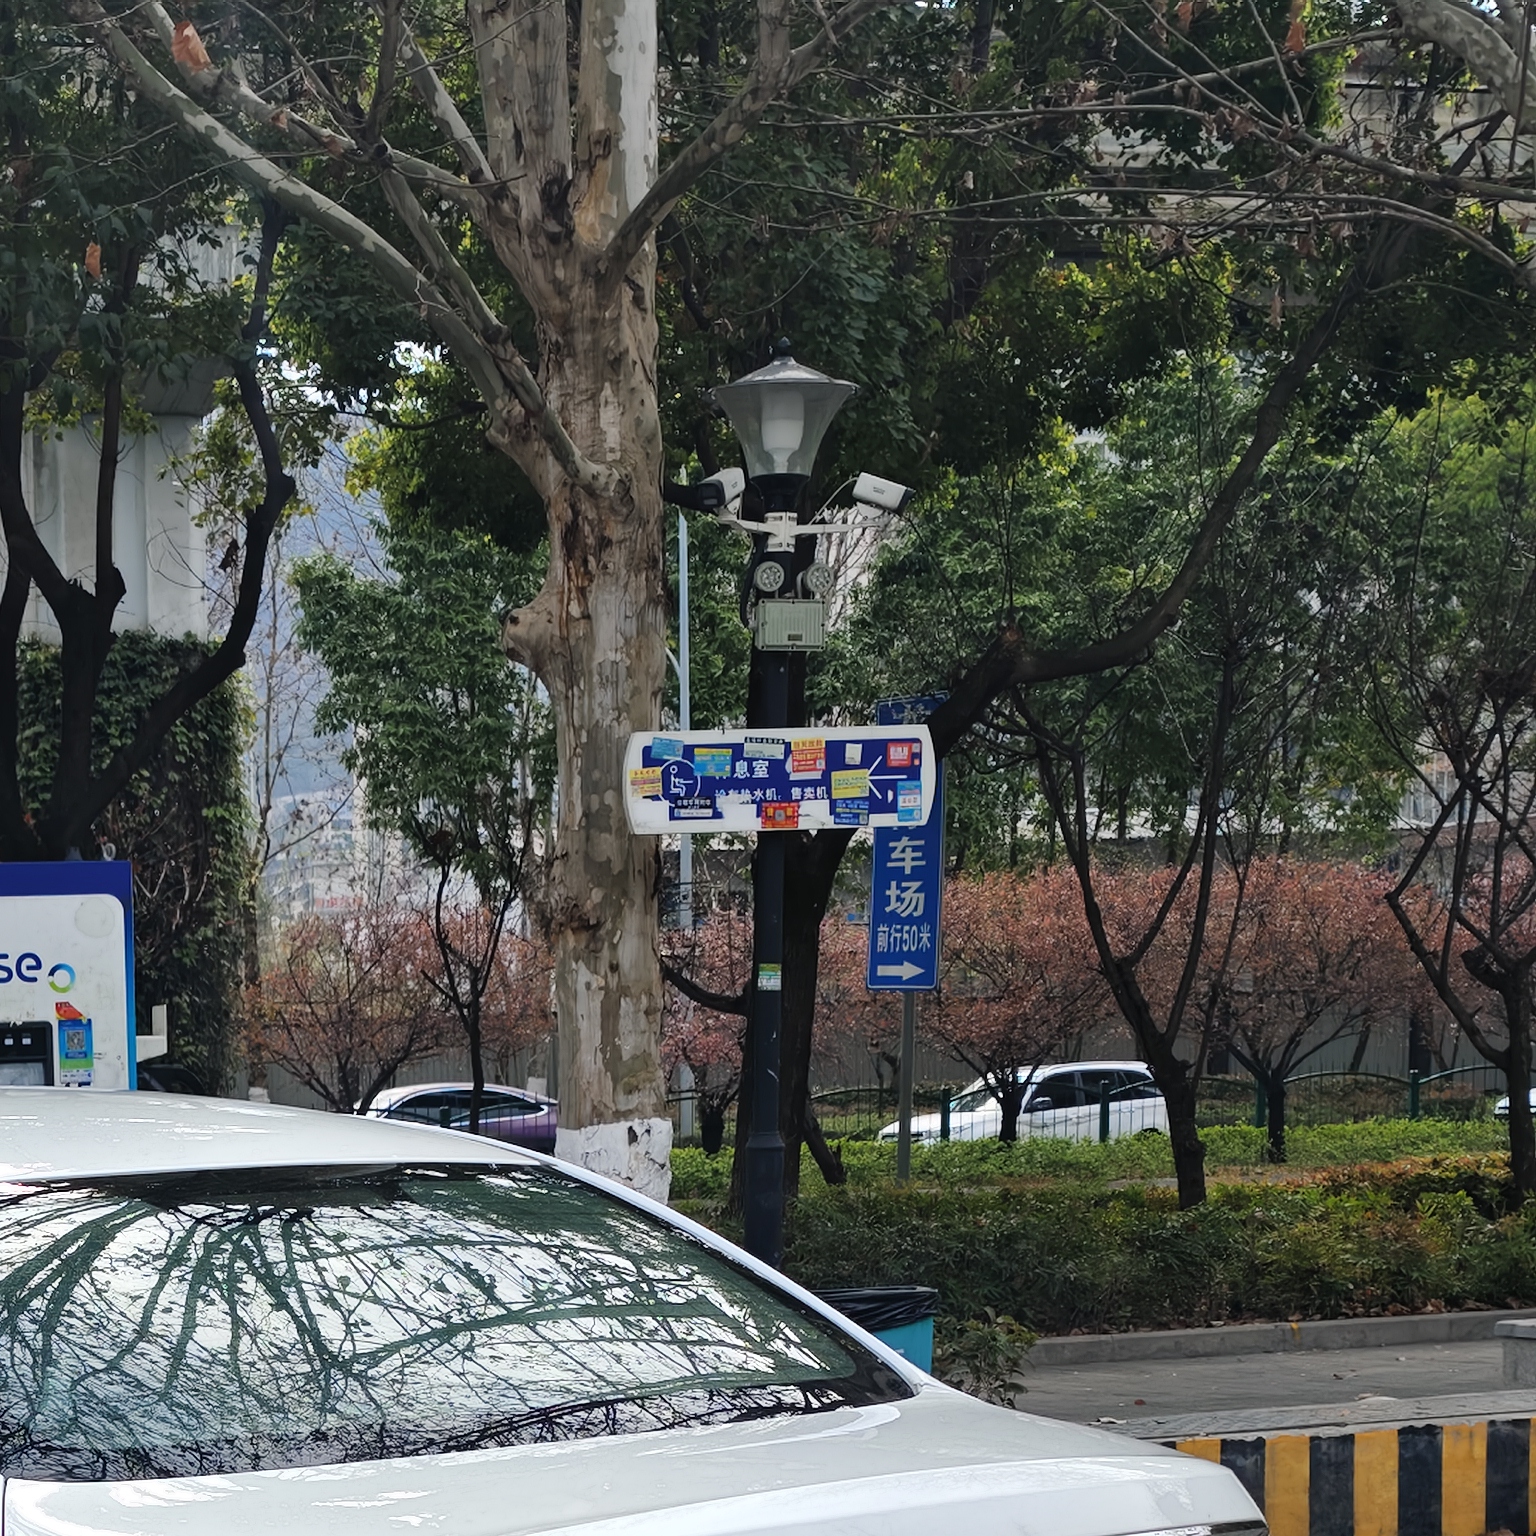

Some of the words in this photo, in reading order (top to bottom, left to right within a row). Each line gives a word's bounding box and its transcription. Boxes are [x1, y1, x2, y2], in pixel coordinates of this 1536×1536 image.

[714, 760, 769, 779] 息室
[885, 827, 926, 917] 车场
[877, 922, 931, 953] 前行50米
